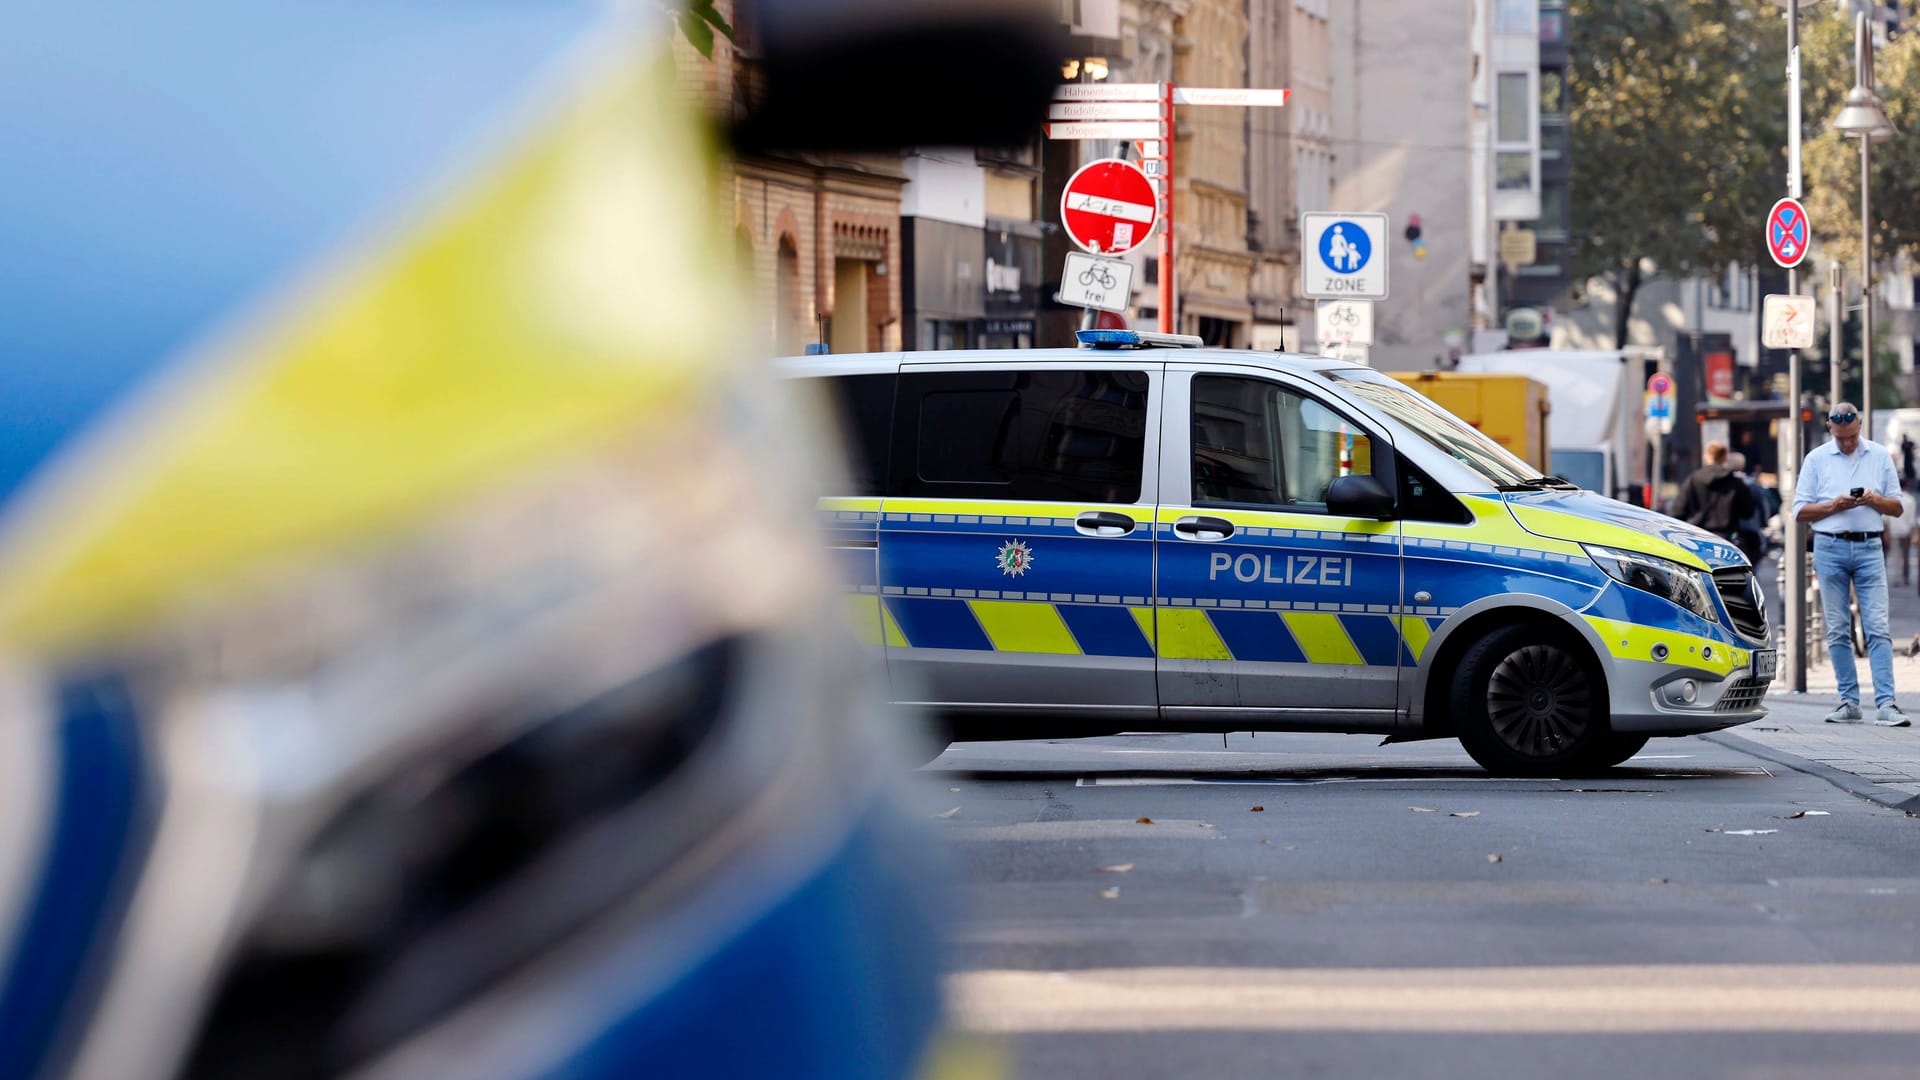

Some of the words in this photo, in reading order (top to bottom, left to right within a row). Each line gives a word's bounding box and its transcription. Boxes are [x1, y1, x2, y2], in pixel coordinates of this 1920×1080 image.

[1325, 278, 1366, 291] ZONE
[1085, 289, 1106, 302] frei
[1209, 552, 1352, 587] POLIZEI
